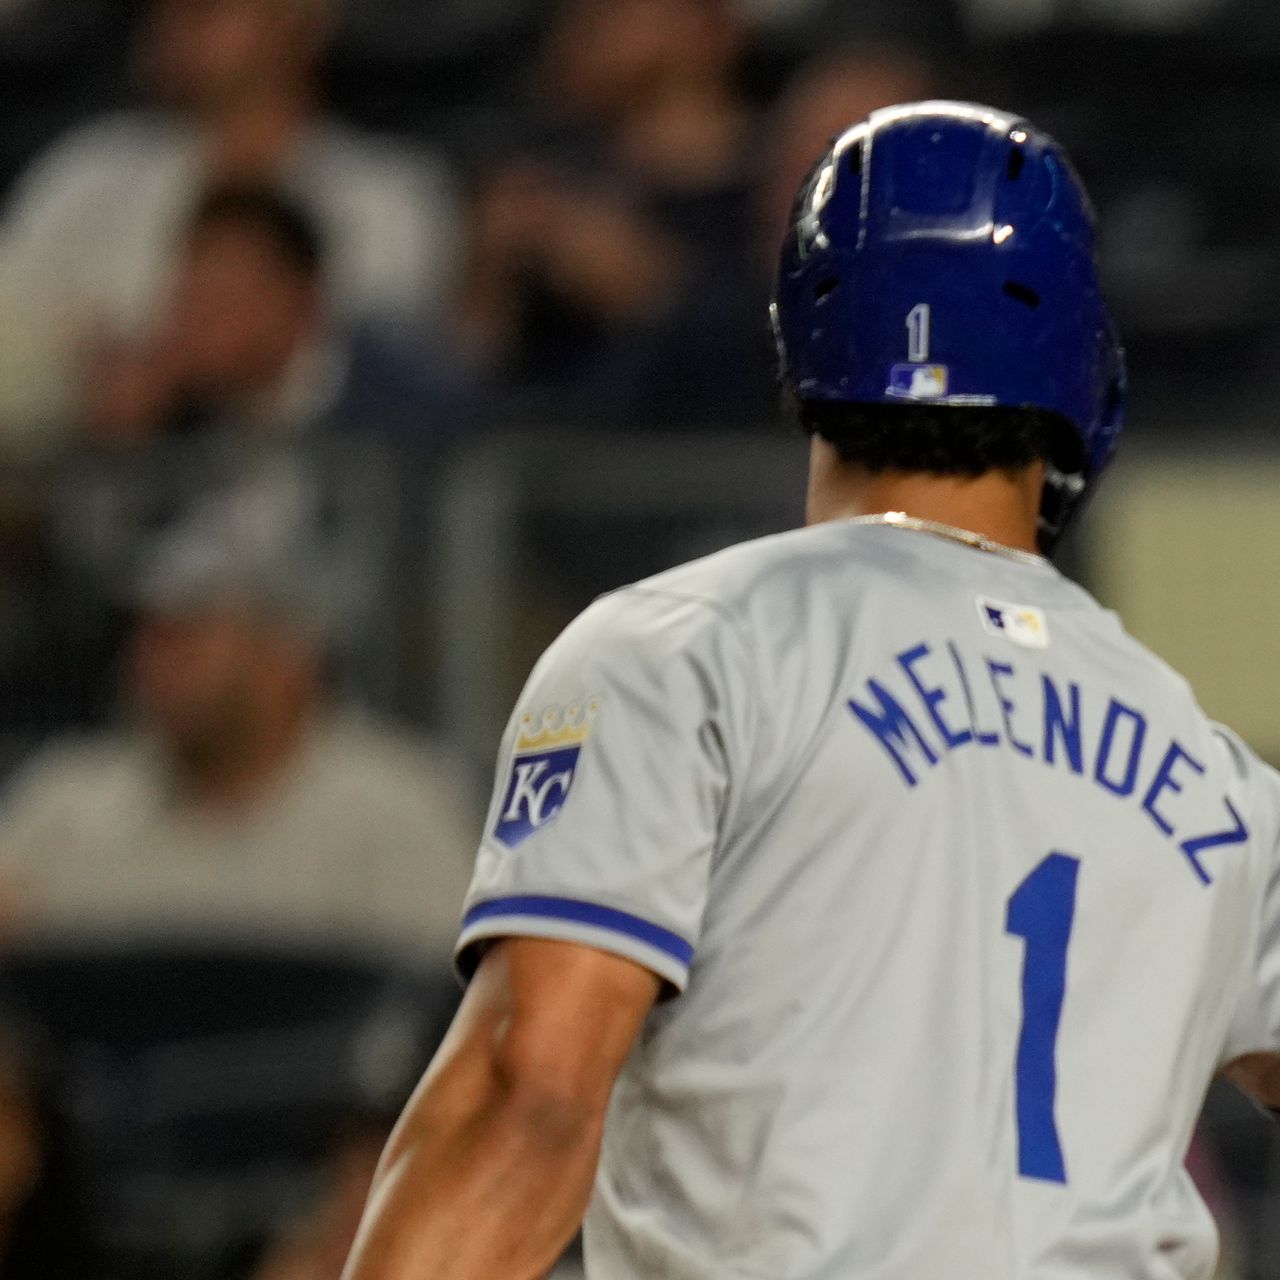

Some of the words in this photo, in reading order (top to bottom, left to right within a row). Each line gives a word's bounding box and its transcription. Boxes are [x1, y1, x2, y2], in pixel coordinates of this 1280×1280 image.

[906, 303, 931, 362] 1
[501, 758, 575, 828] KC
[847, 641, 1249, 887] MELENDEZ
[1005, 851, 1081, 1186] 1
